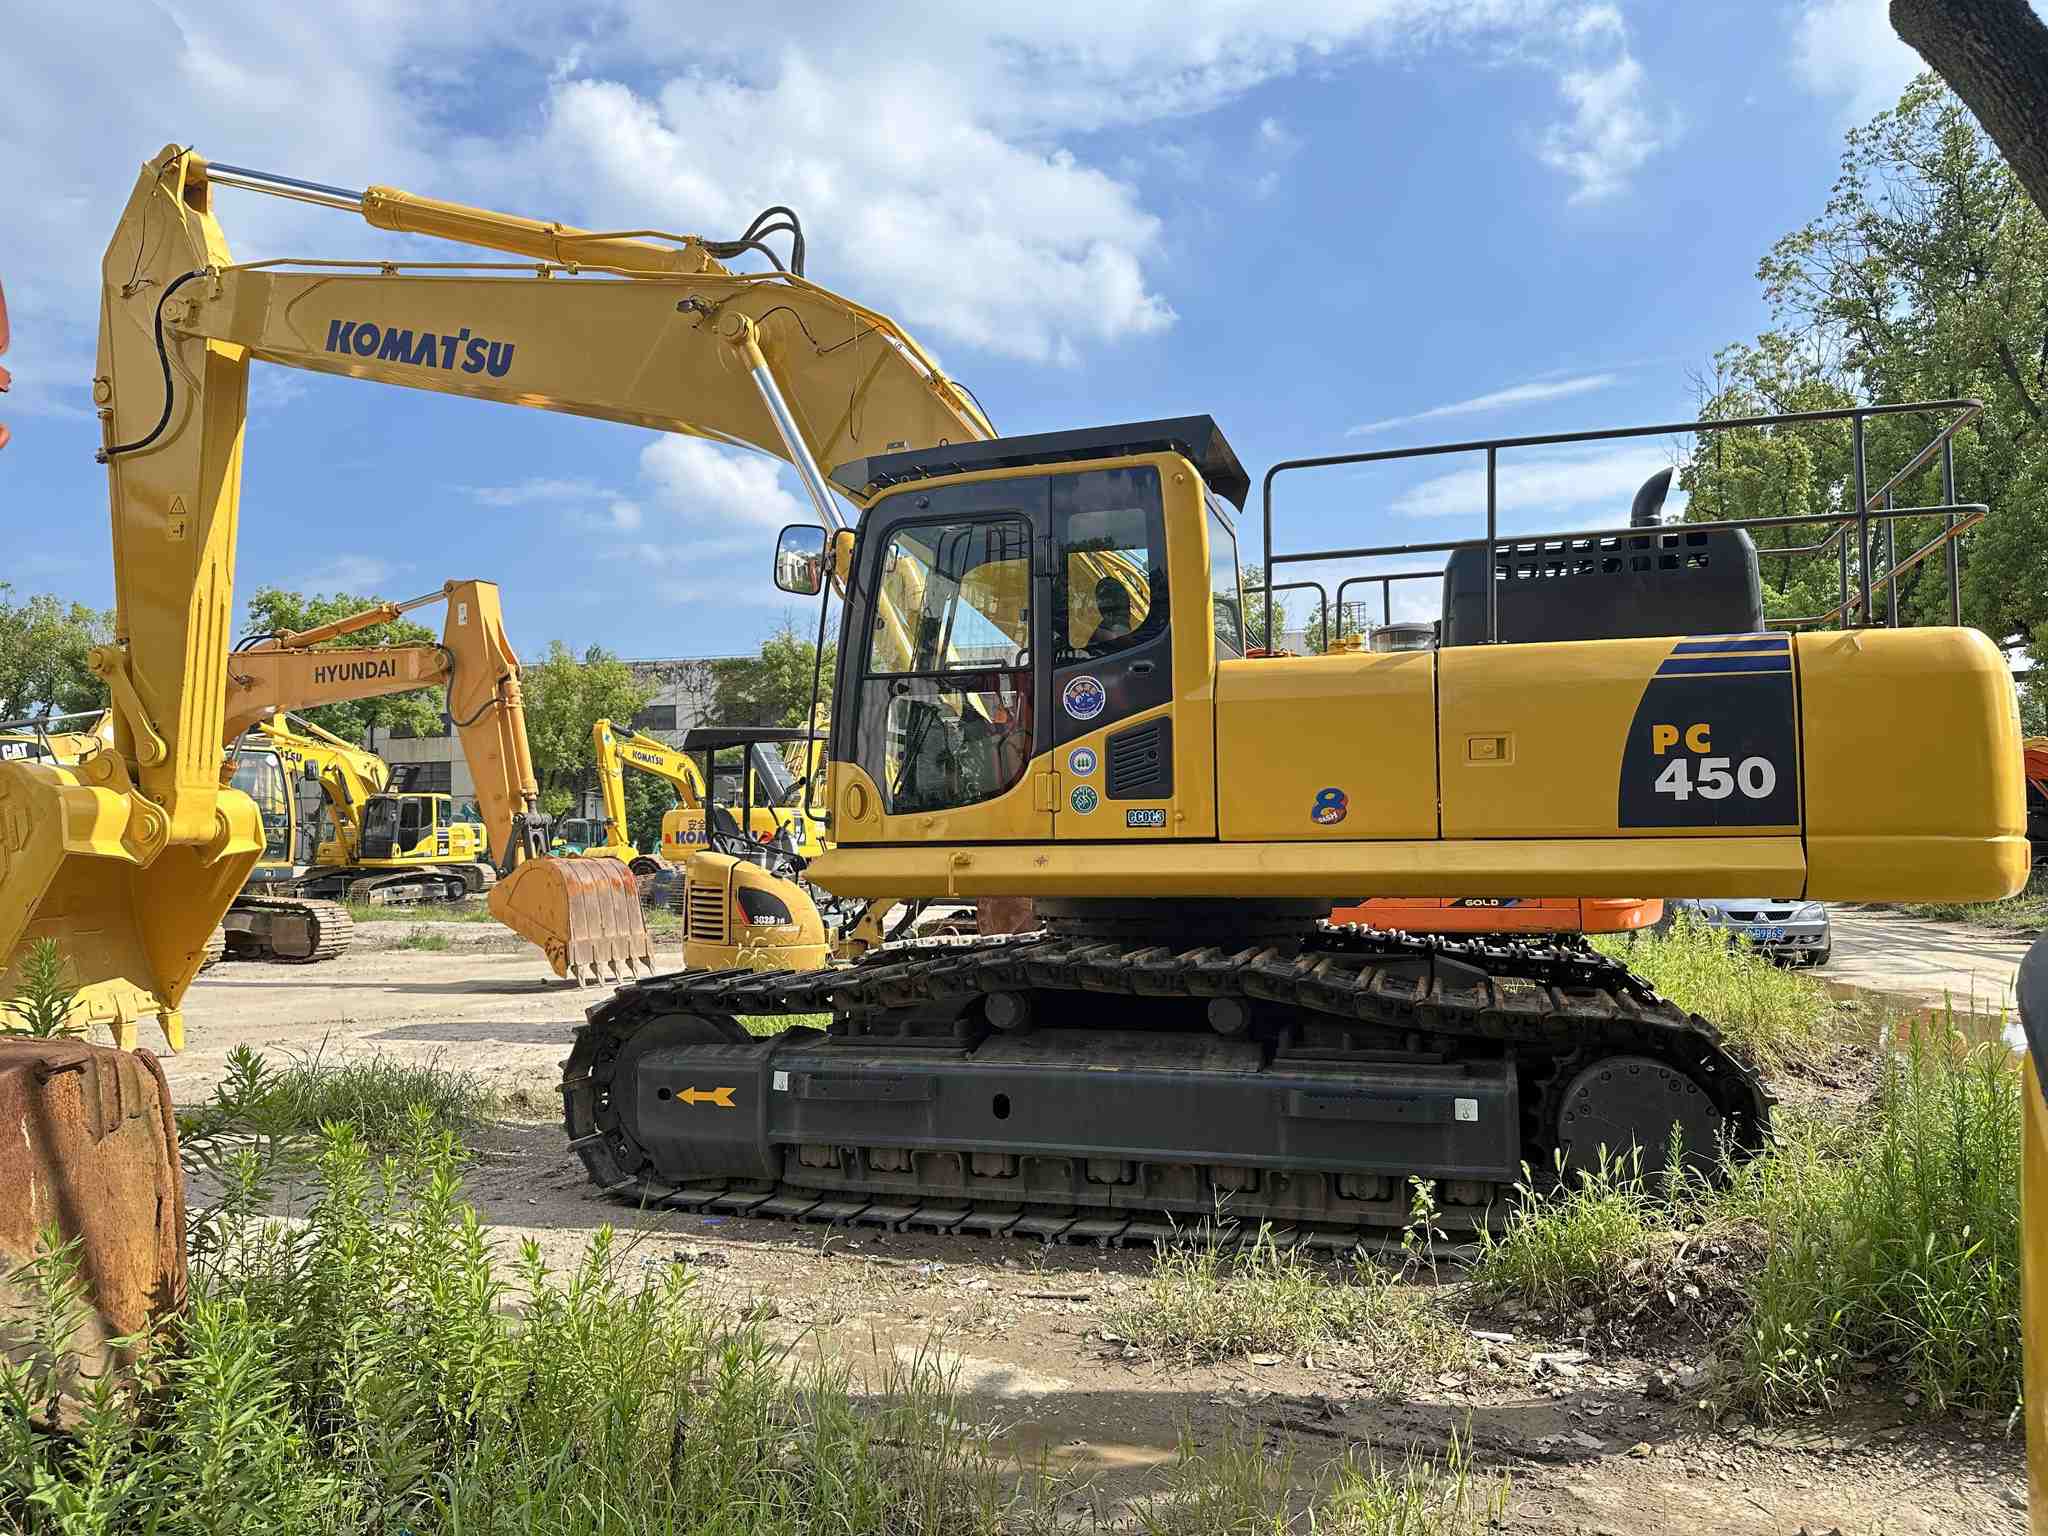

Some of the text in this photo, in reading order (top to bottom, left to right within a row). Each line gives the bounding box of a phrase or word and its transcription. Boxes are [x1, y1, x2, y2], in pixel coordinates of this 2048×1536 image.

[326, 319, 515, 377] KOMATSU
[314, 658, 396, 684] HYUNDAI
[1, 742, 28, 760] CAT
[1652, 723, 1711, 755] PC
[632, 750, 664, 766] KOMATSU
[1654, 756, 1776, 801] 450
[1464, 898, 1499, 906] GOLD
